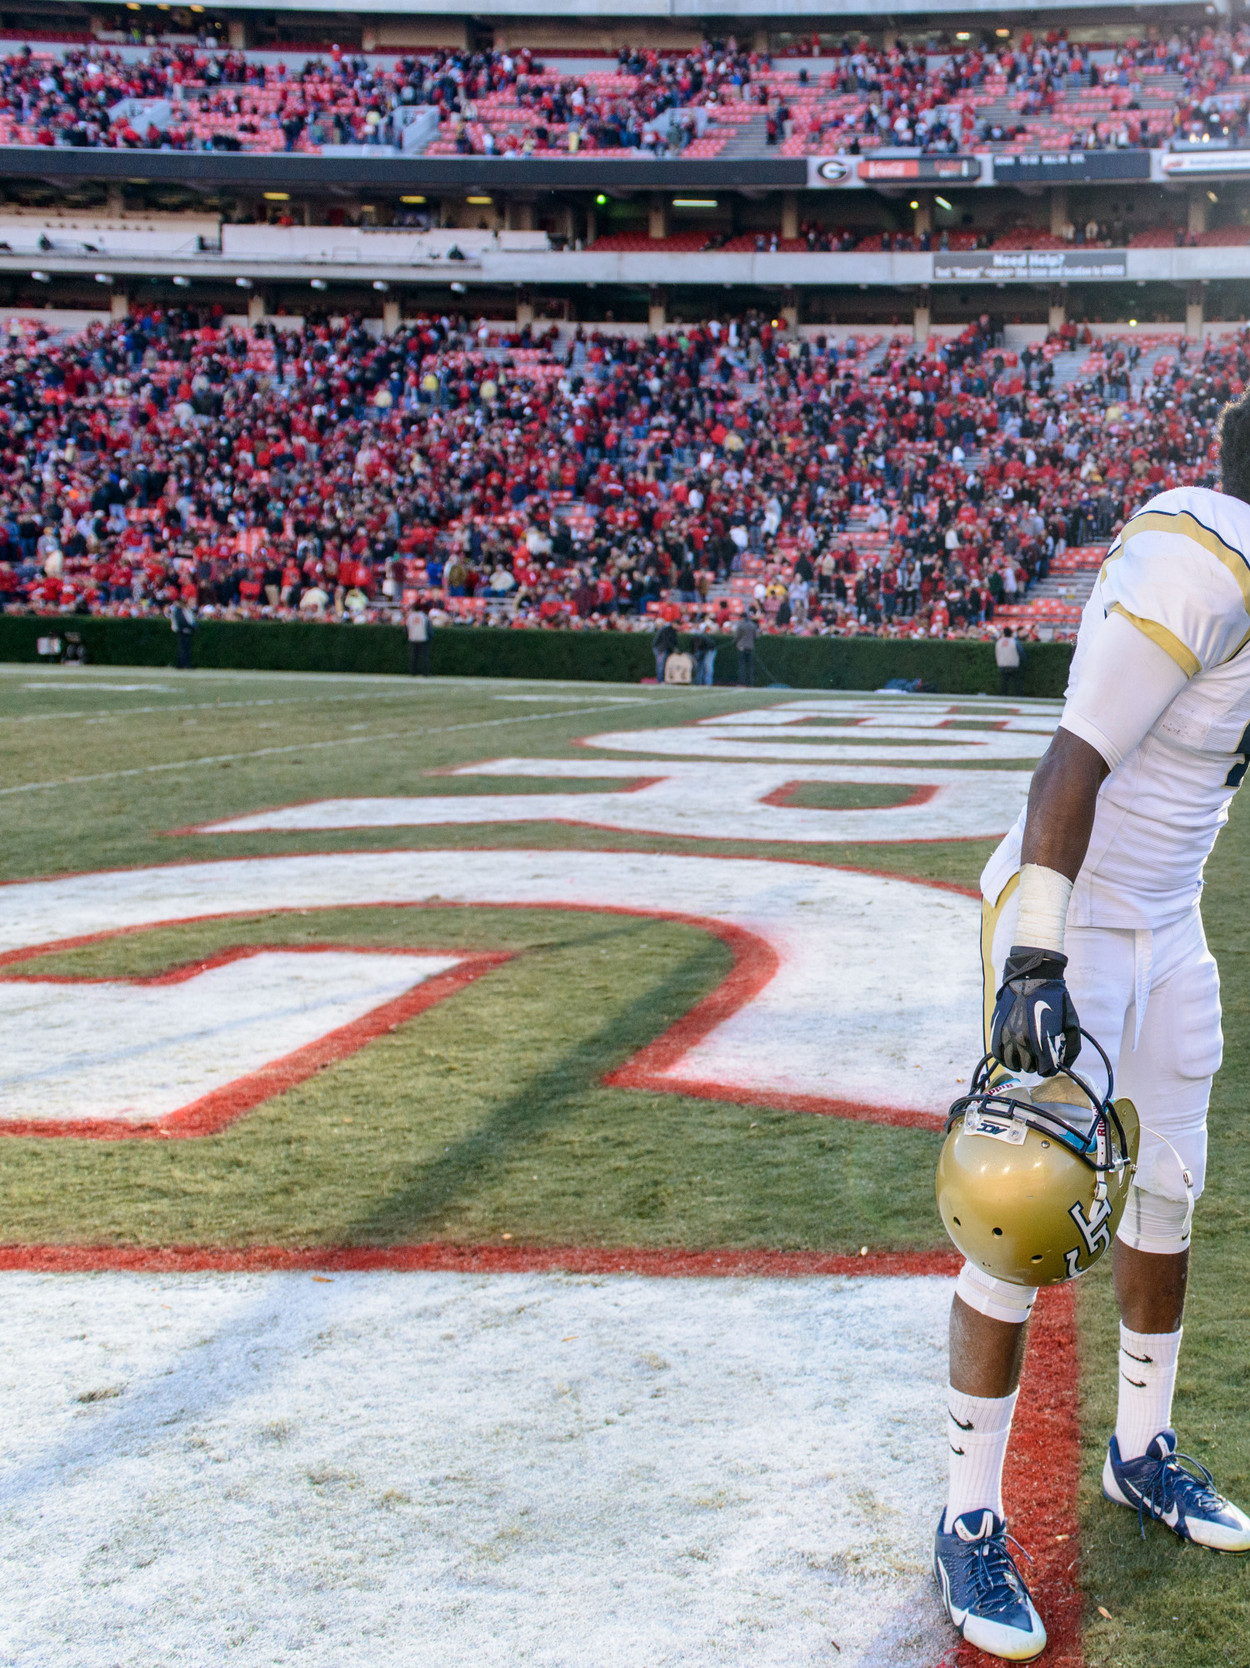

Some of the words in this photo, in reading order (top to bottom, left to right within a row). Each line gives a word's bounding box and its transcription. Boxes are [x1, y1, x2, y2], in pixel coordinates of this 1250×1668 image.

[820, 161, 849, 180] G
[992, 253, 1028, 268] Need
[1029, 253, 1065, 268] Help?
[976, 1122, 1008, 1136] ACC
